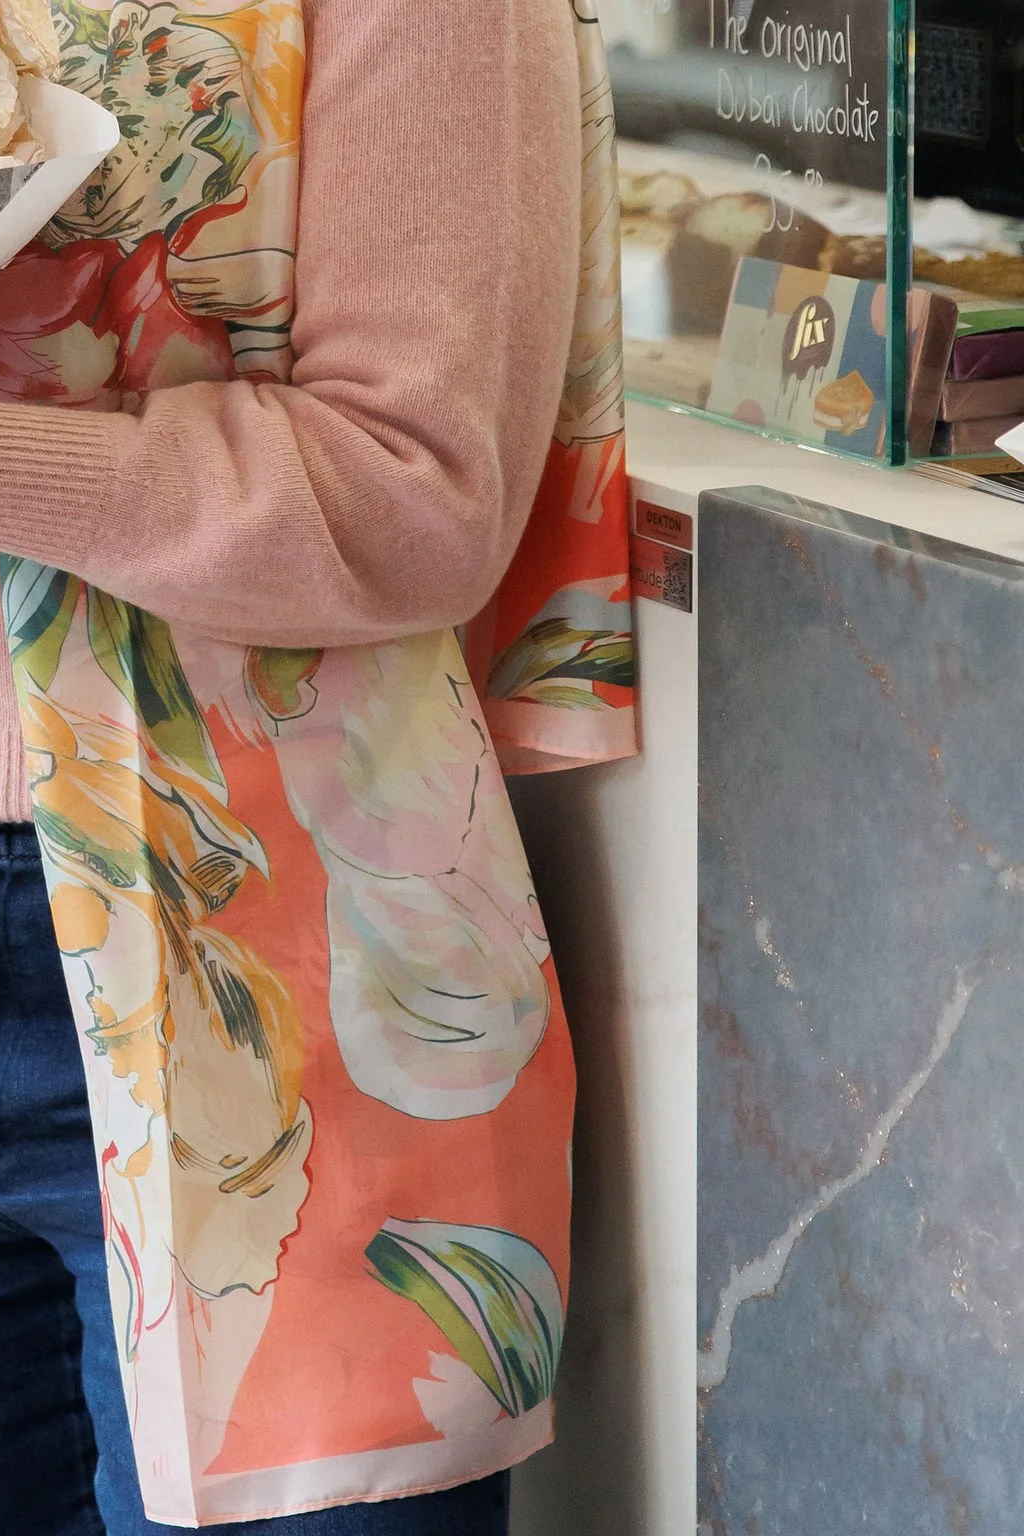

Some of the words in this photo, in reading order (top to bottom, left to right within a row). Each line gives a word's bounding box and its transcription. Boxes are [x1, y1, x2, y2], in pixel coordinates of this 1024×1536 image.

[717, 67, 781, 128] Dubai
[792, 79, 879, 142] Chocolate
[789, 302, 830, 361] fix
[647, 510, 682, 532] DEKTON
